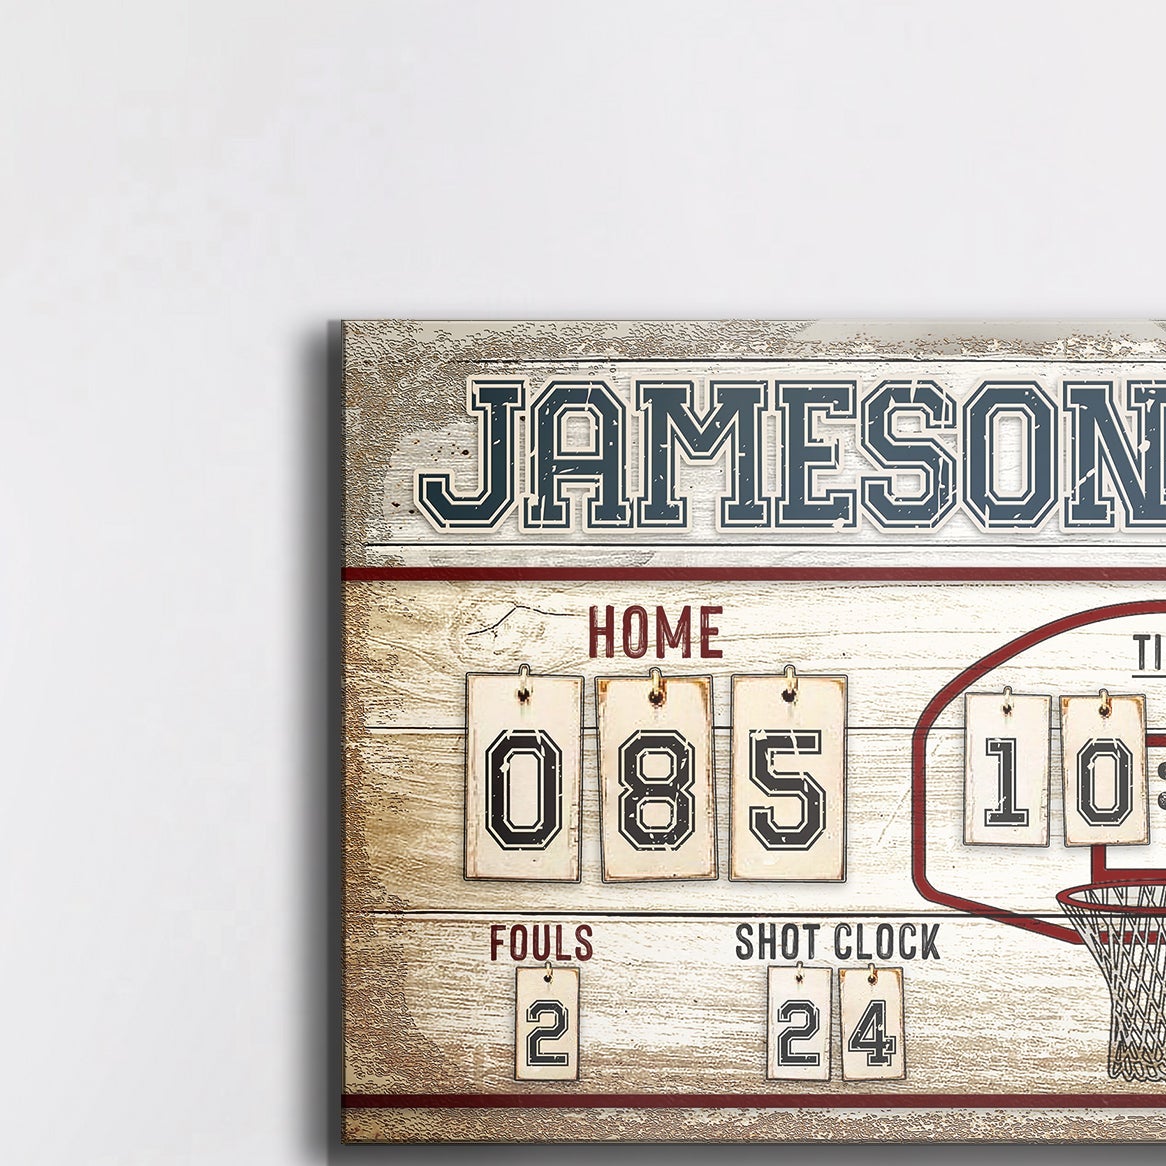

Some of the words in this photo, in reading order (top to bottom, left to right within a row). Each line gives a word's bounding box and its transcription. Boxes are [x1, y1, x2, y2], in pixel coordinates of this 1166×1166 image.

[588, 605, 724, 659] HOME
[490, 924, 594, 961] FOULS
[735, 923, 824, 961] SHOT
[834, 923, 941, 961] CLOCK
[526, 1000, 570, 1067] 2
